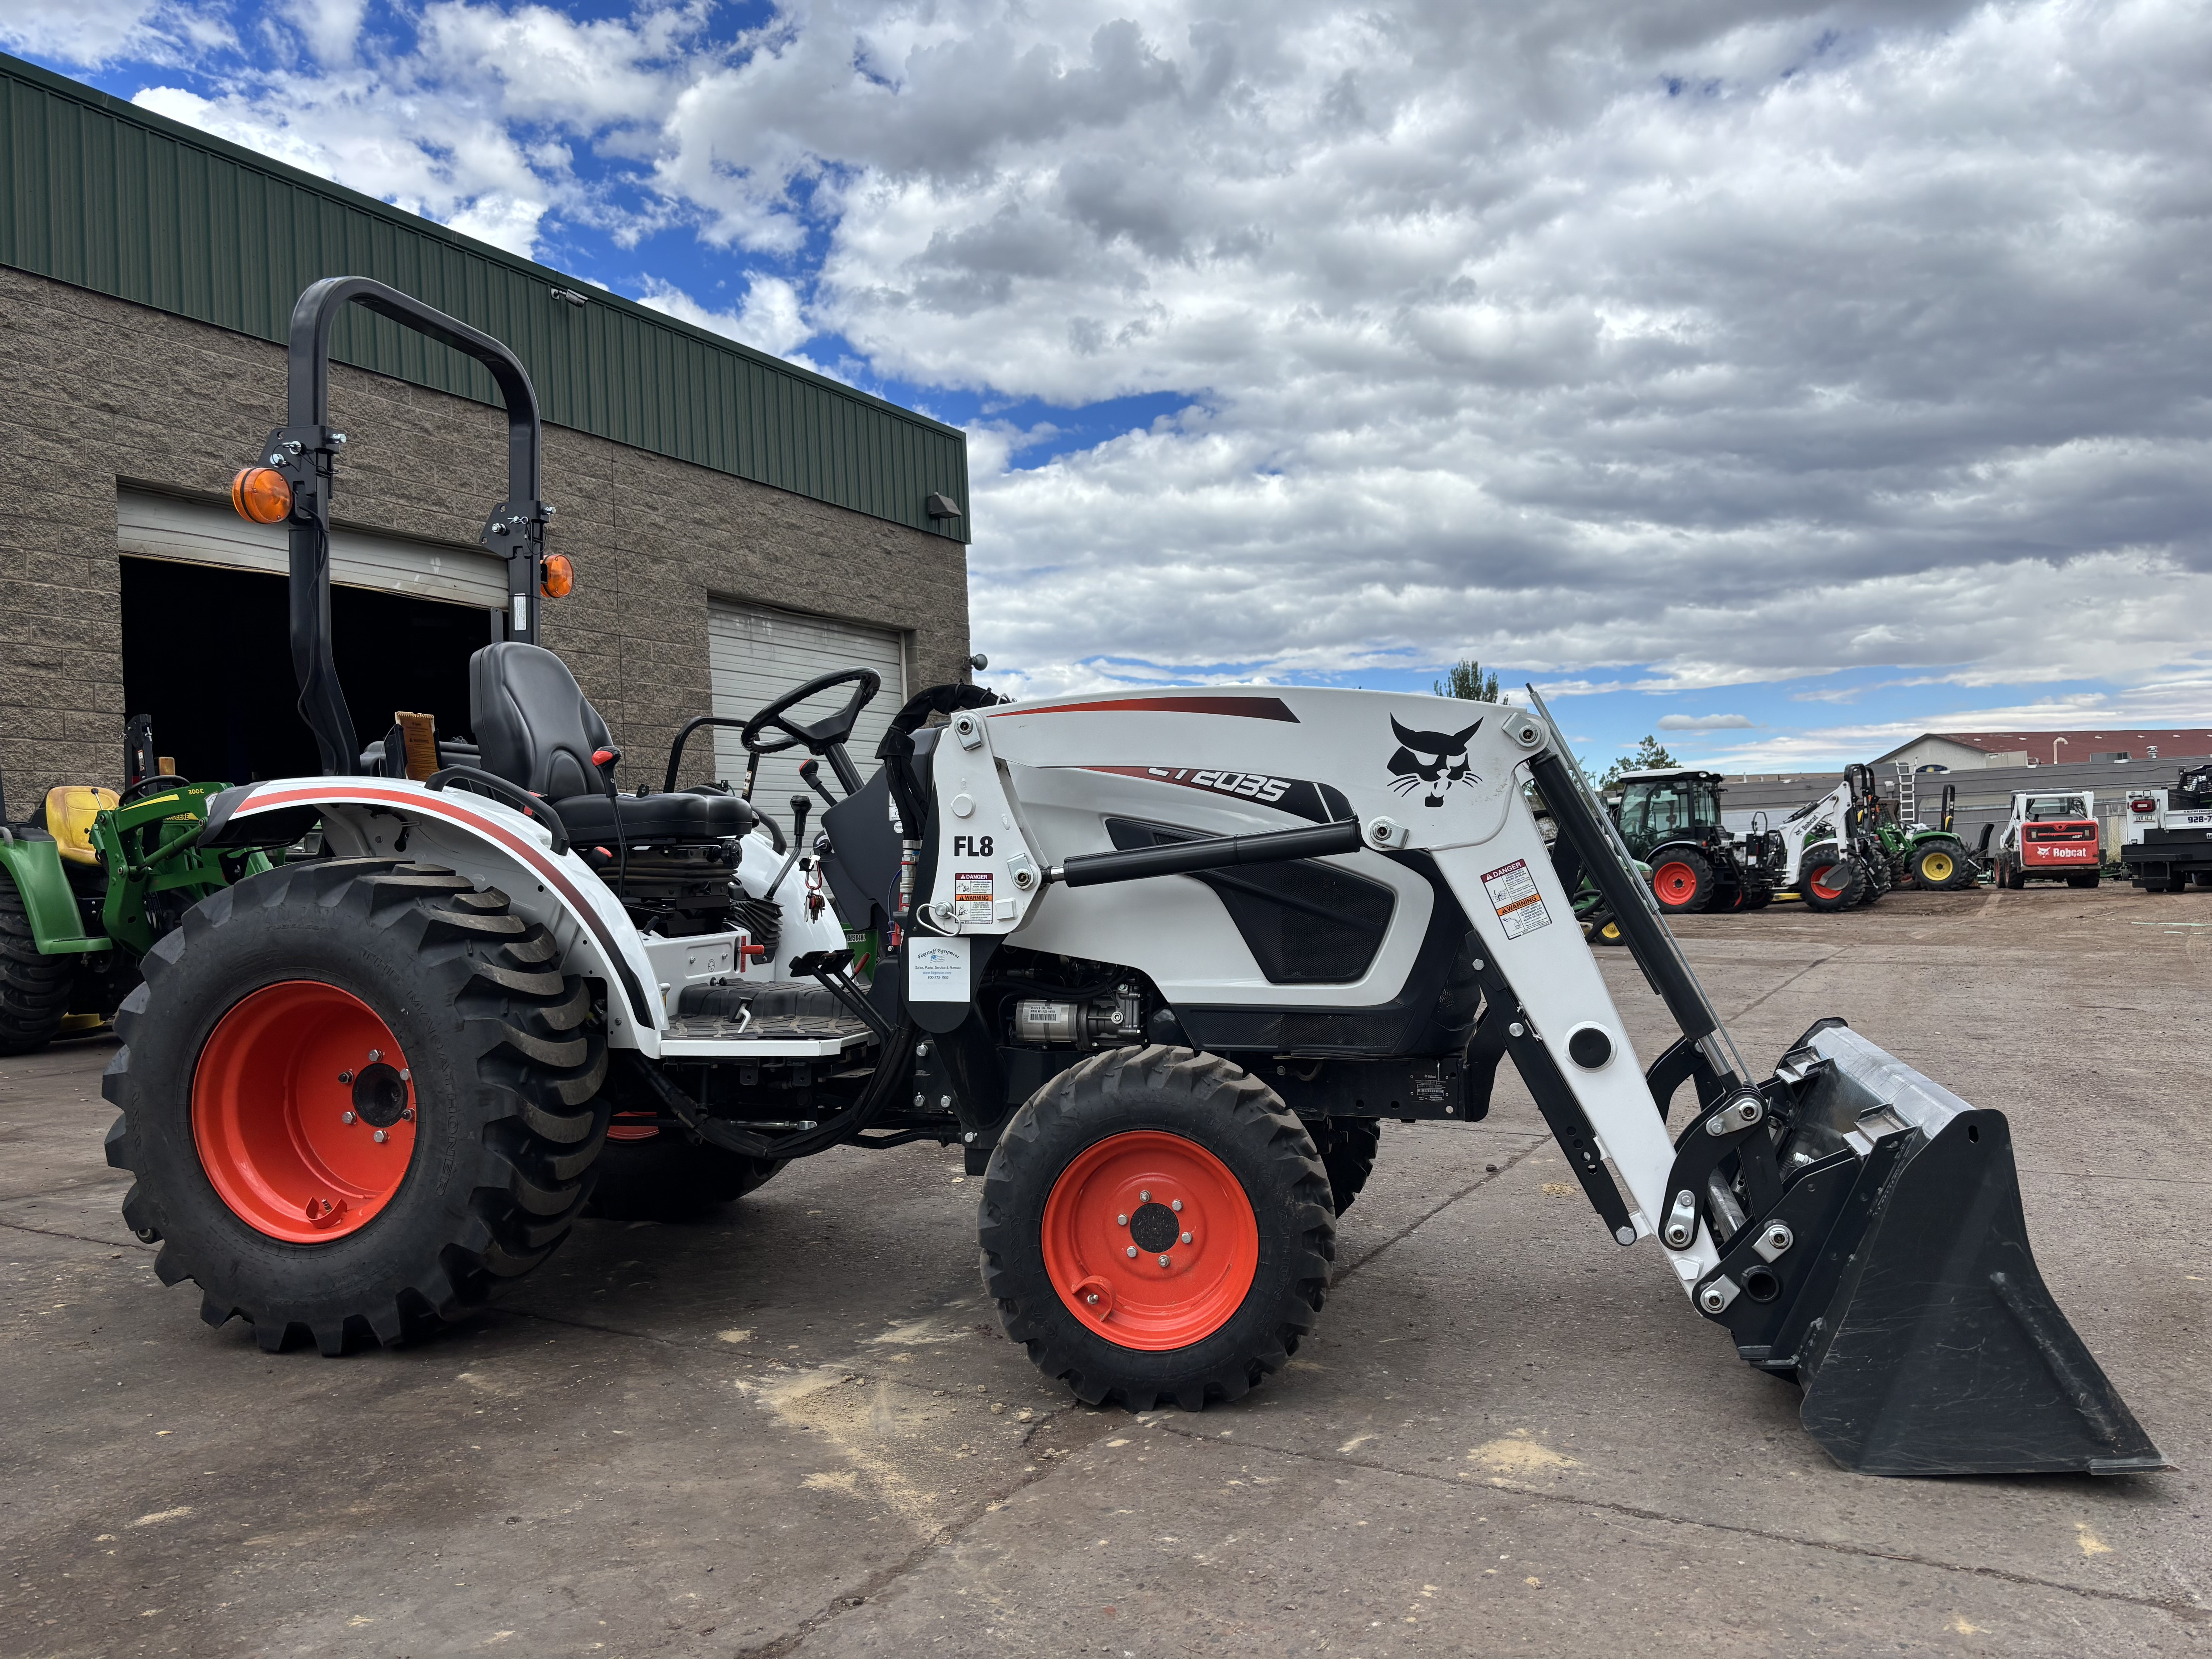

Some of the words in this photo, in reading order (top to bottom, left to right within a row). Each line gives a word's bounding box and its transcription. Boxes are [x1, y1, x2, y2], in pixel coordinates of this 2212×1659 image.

[1802, 815, 1818, 831] Bobcat
[954, 836, 993, 857] FL8
[2053, 848, 2087, 857] Bobcat
[1492, 862, 1522, 878] DANGER
[1506, 896, 1537, 911] WARNING
[937, 948, 960, 958] Equipment
